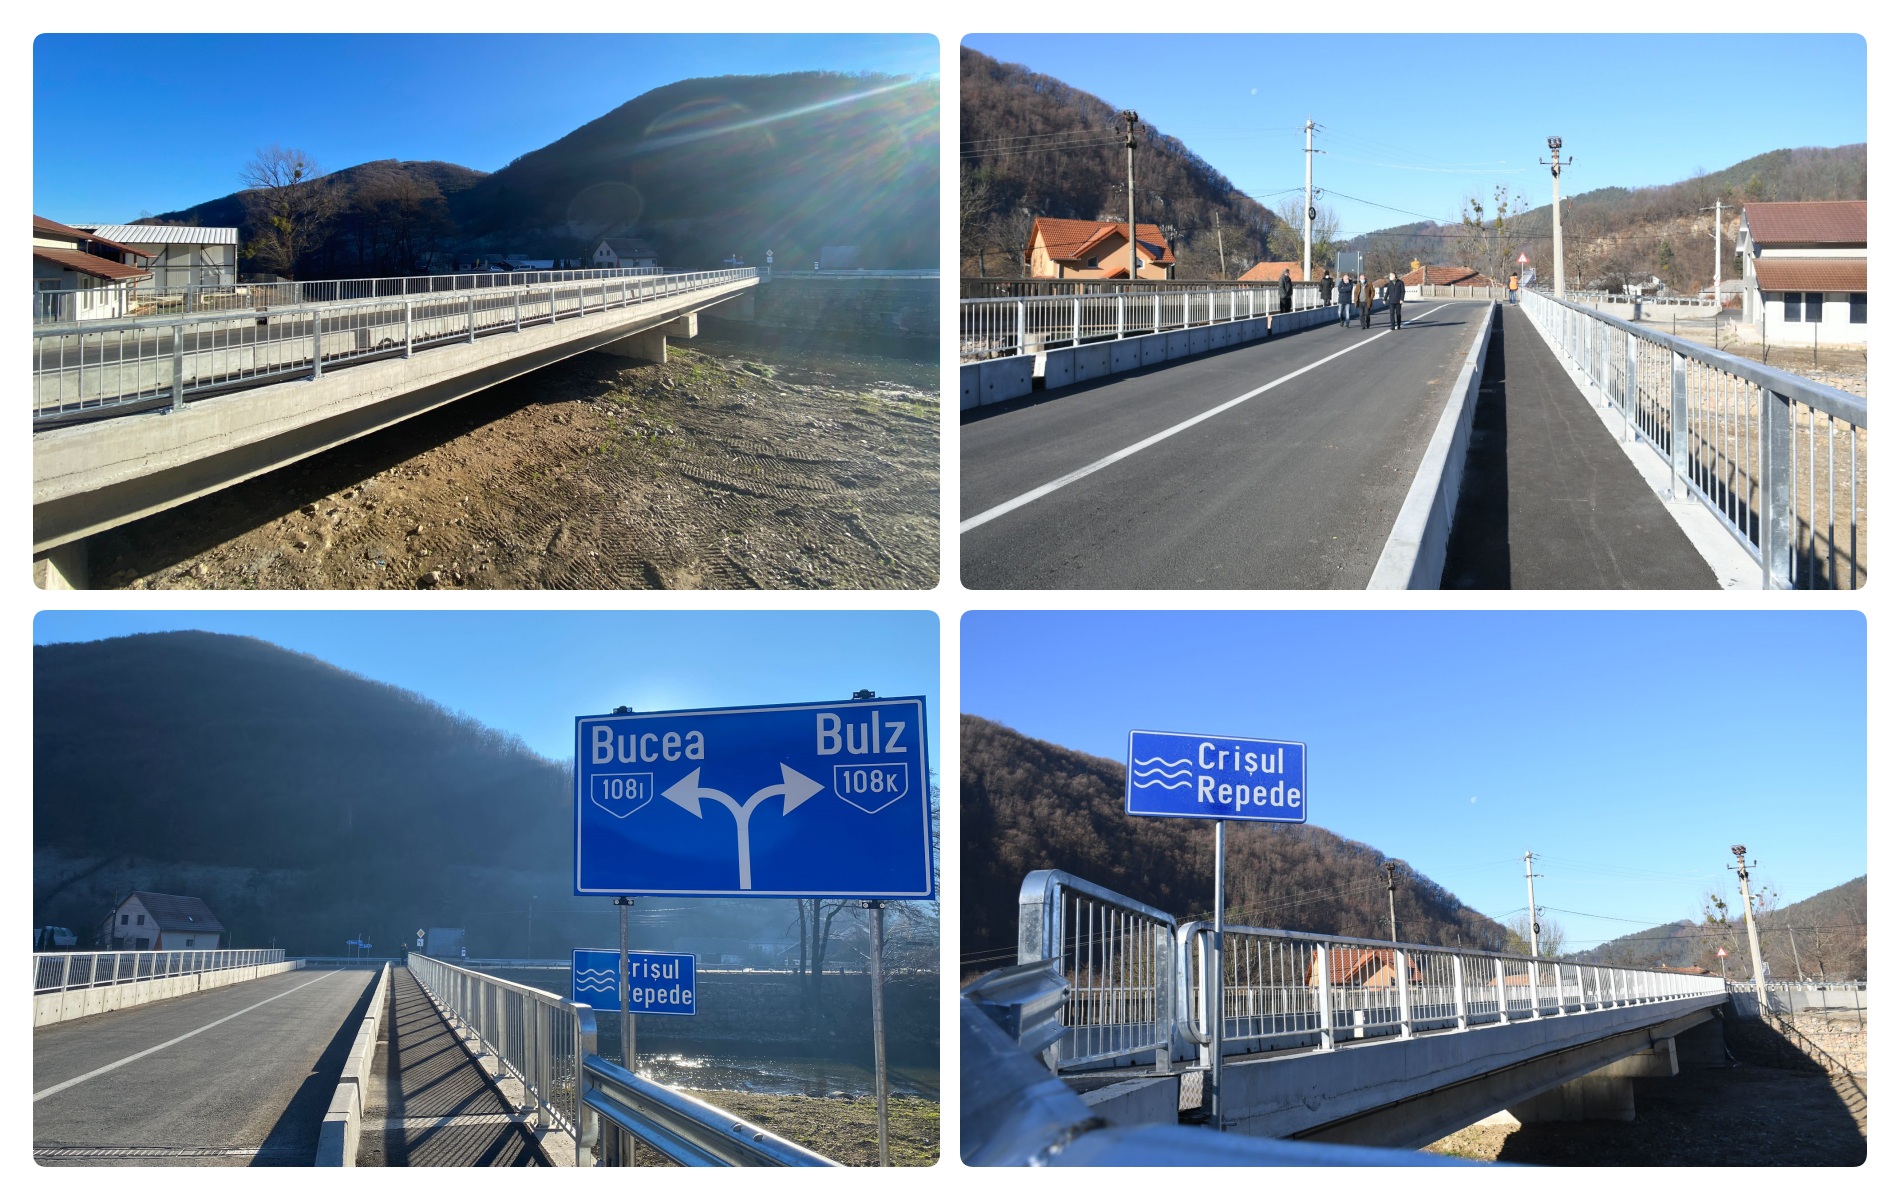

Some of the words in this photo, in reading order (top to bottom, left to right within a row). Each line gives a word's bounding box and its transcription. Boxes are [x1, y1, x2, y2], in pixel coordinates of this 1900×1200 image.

[592, 725, 705, 764] Bucea
[816, 711, 907, 755] Bulz
[1198, 742, 1284, 777] Crișul
[843, 770, 899, 794] 108K
[1197, 775, 1301, 812] Repede
